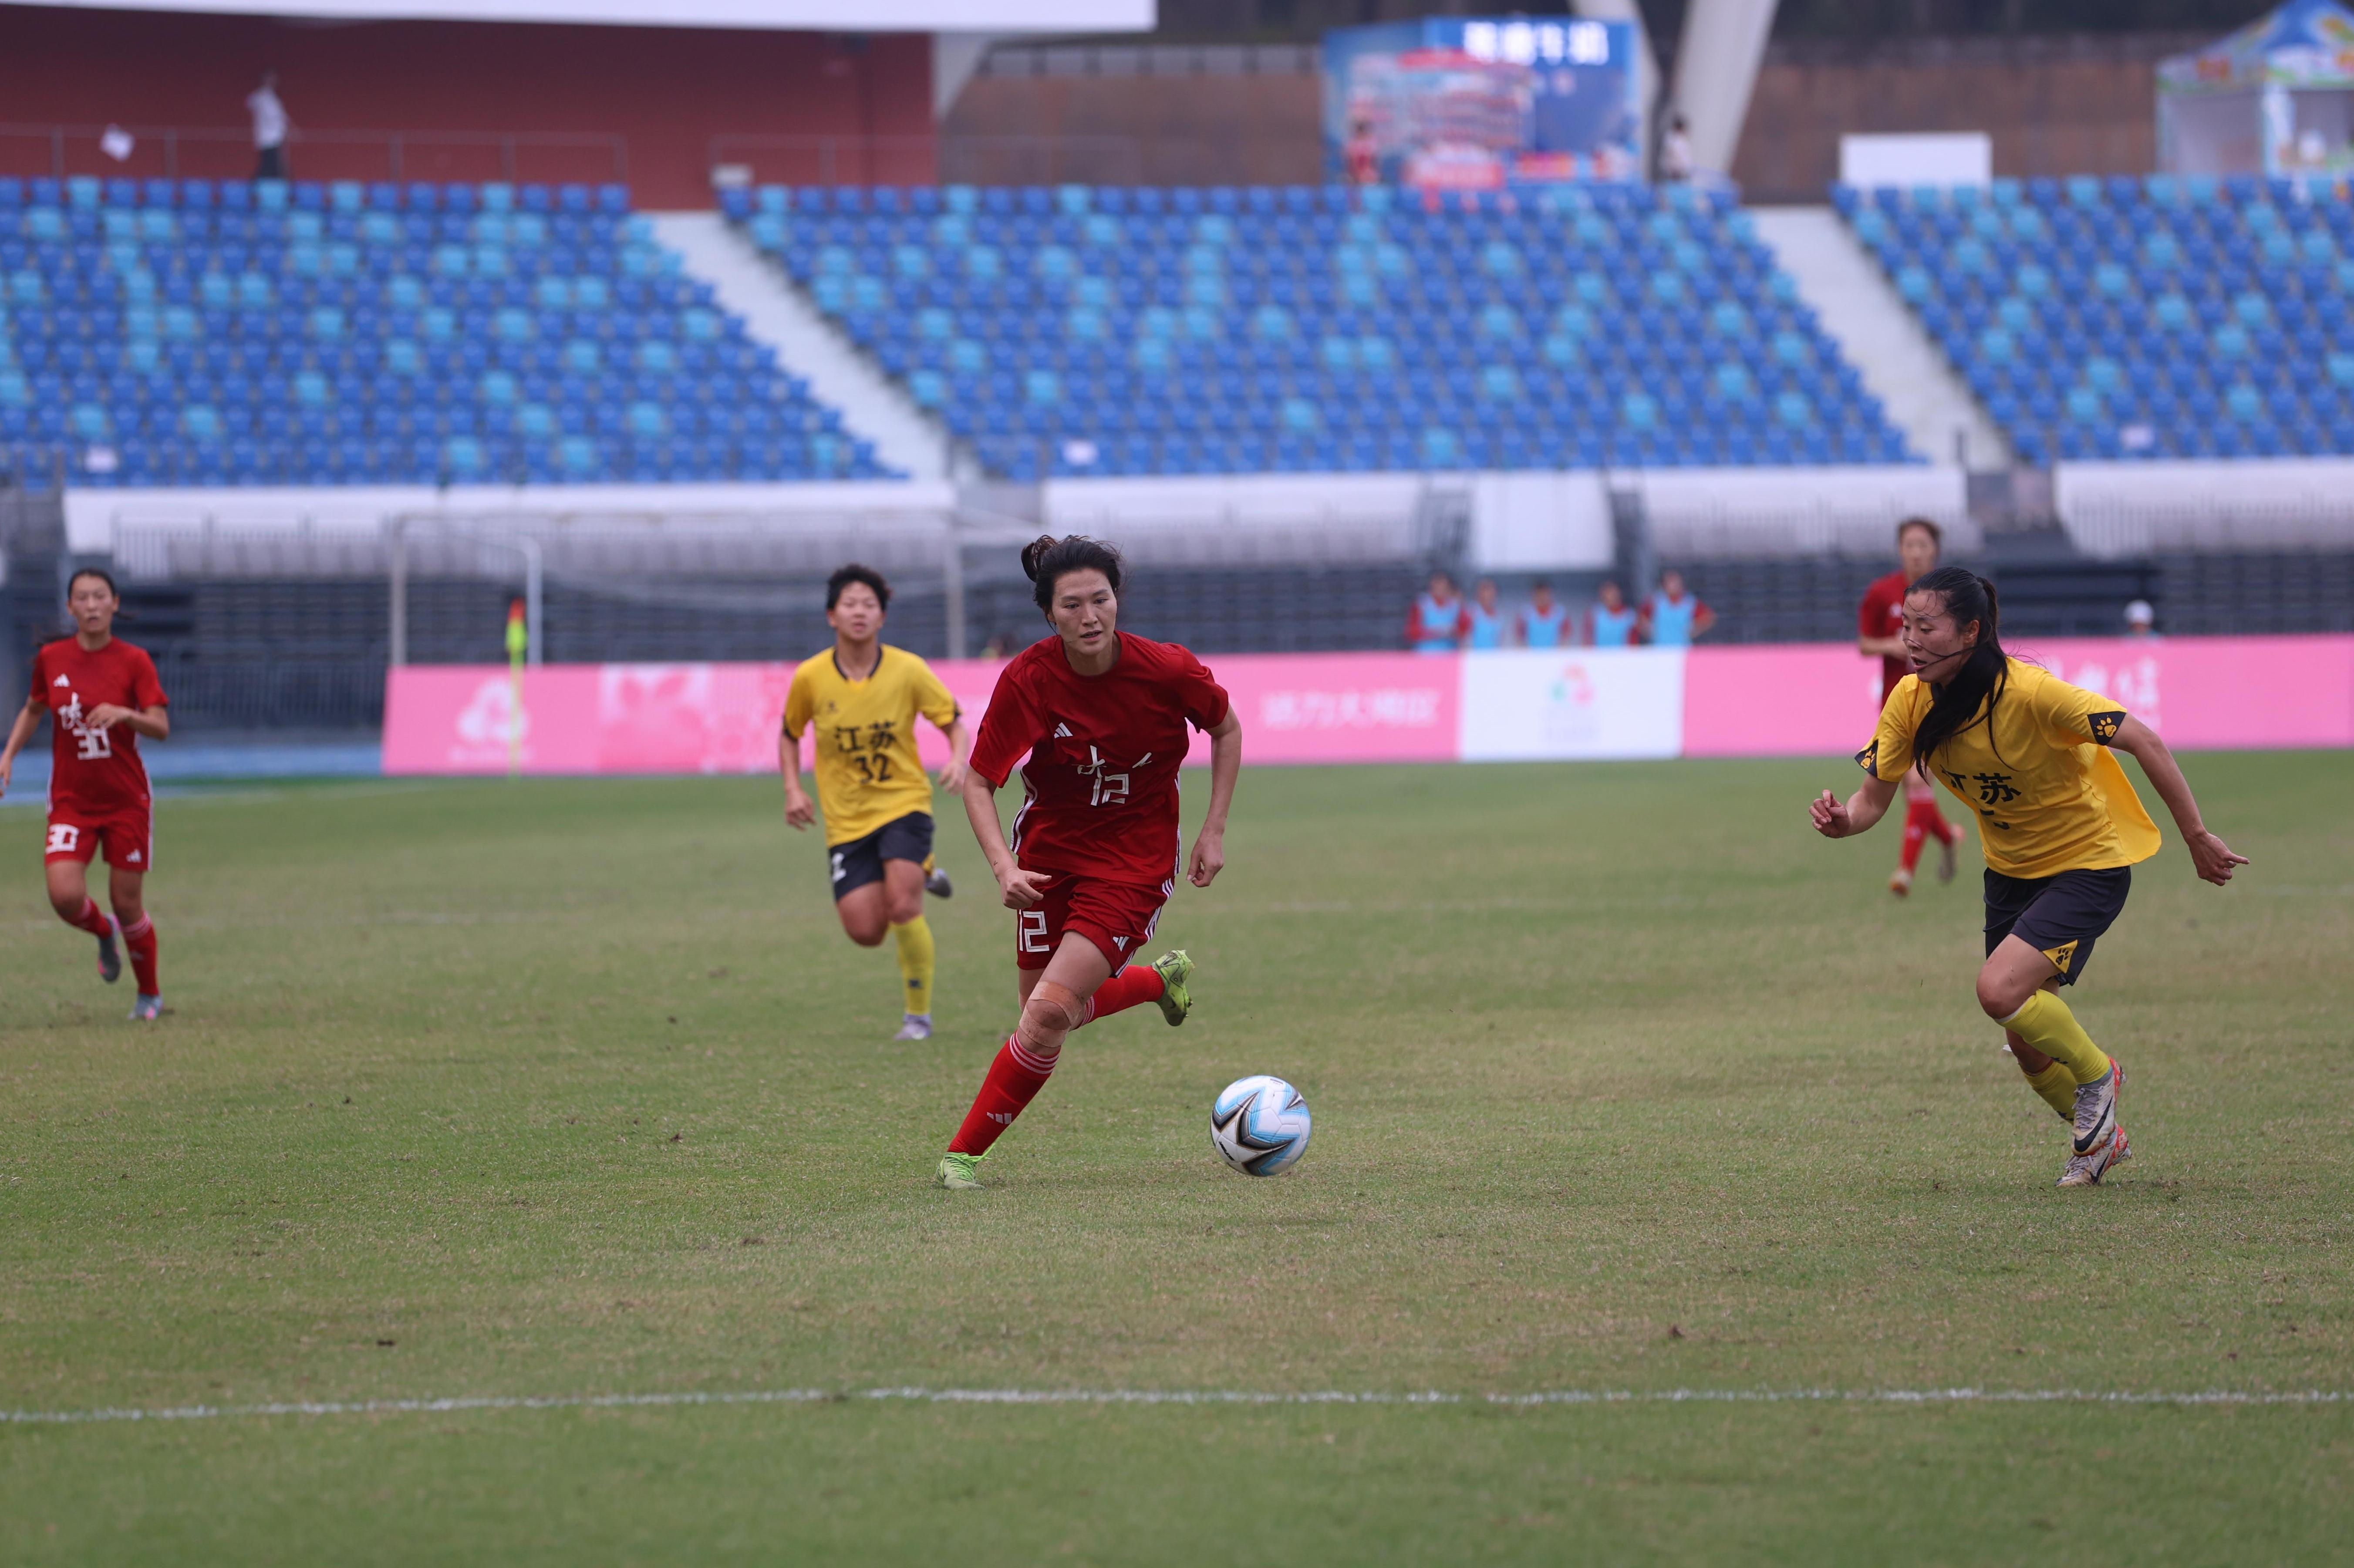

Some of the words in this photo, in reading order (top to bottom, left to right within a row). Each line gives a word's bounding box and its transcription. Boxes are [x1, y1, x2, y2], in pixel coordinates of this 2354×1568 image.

[72, 728, 111, 760] 30
[834, 721, 897, 752] 江苏
[854, 753, 892, 785] 32
[1090, 773, 1129, 806] 12
[45, 823, 79, 854] 30
[1019, 909, 1050, 952] 12
